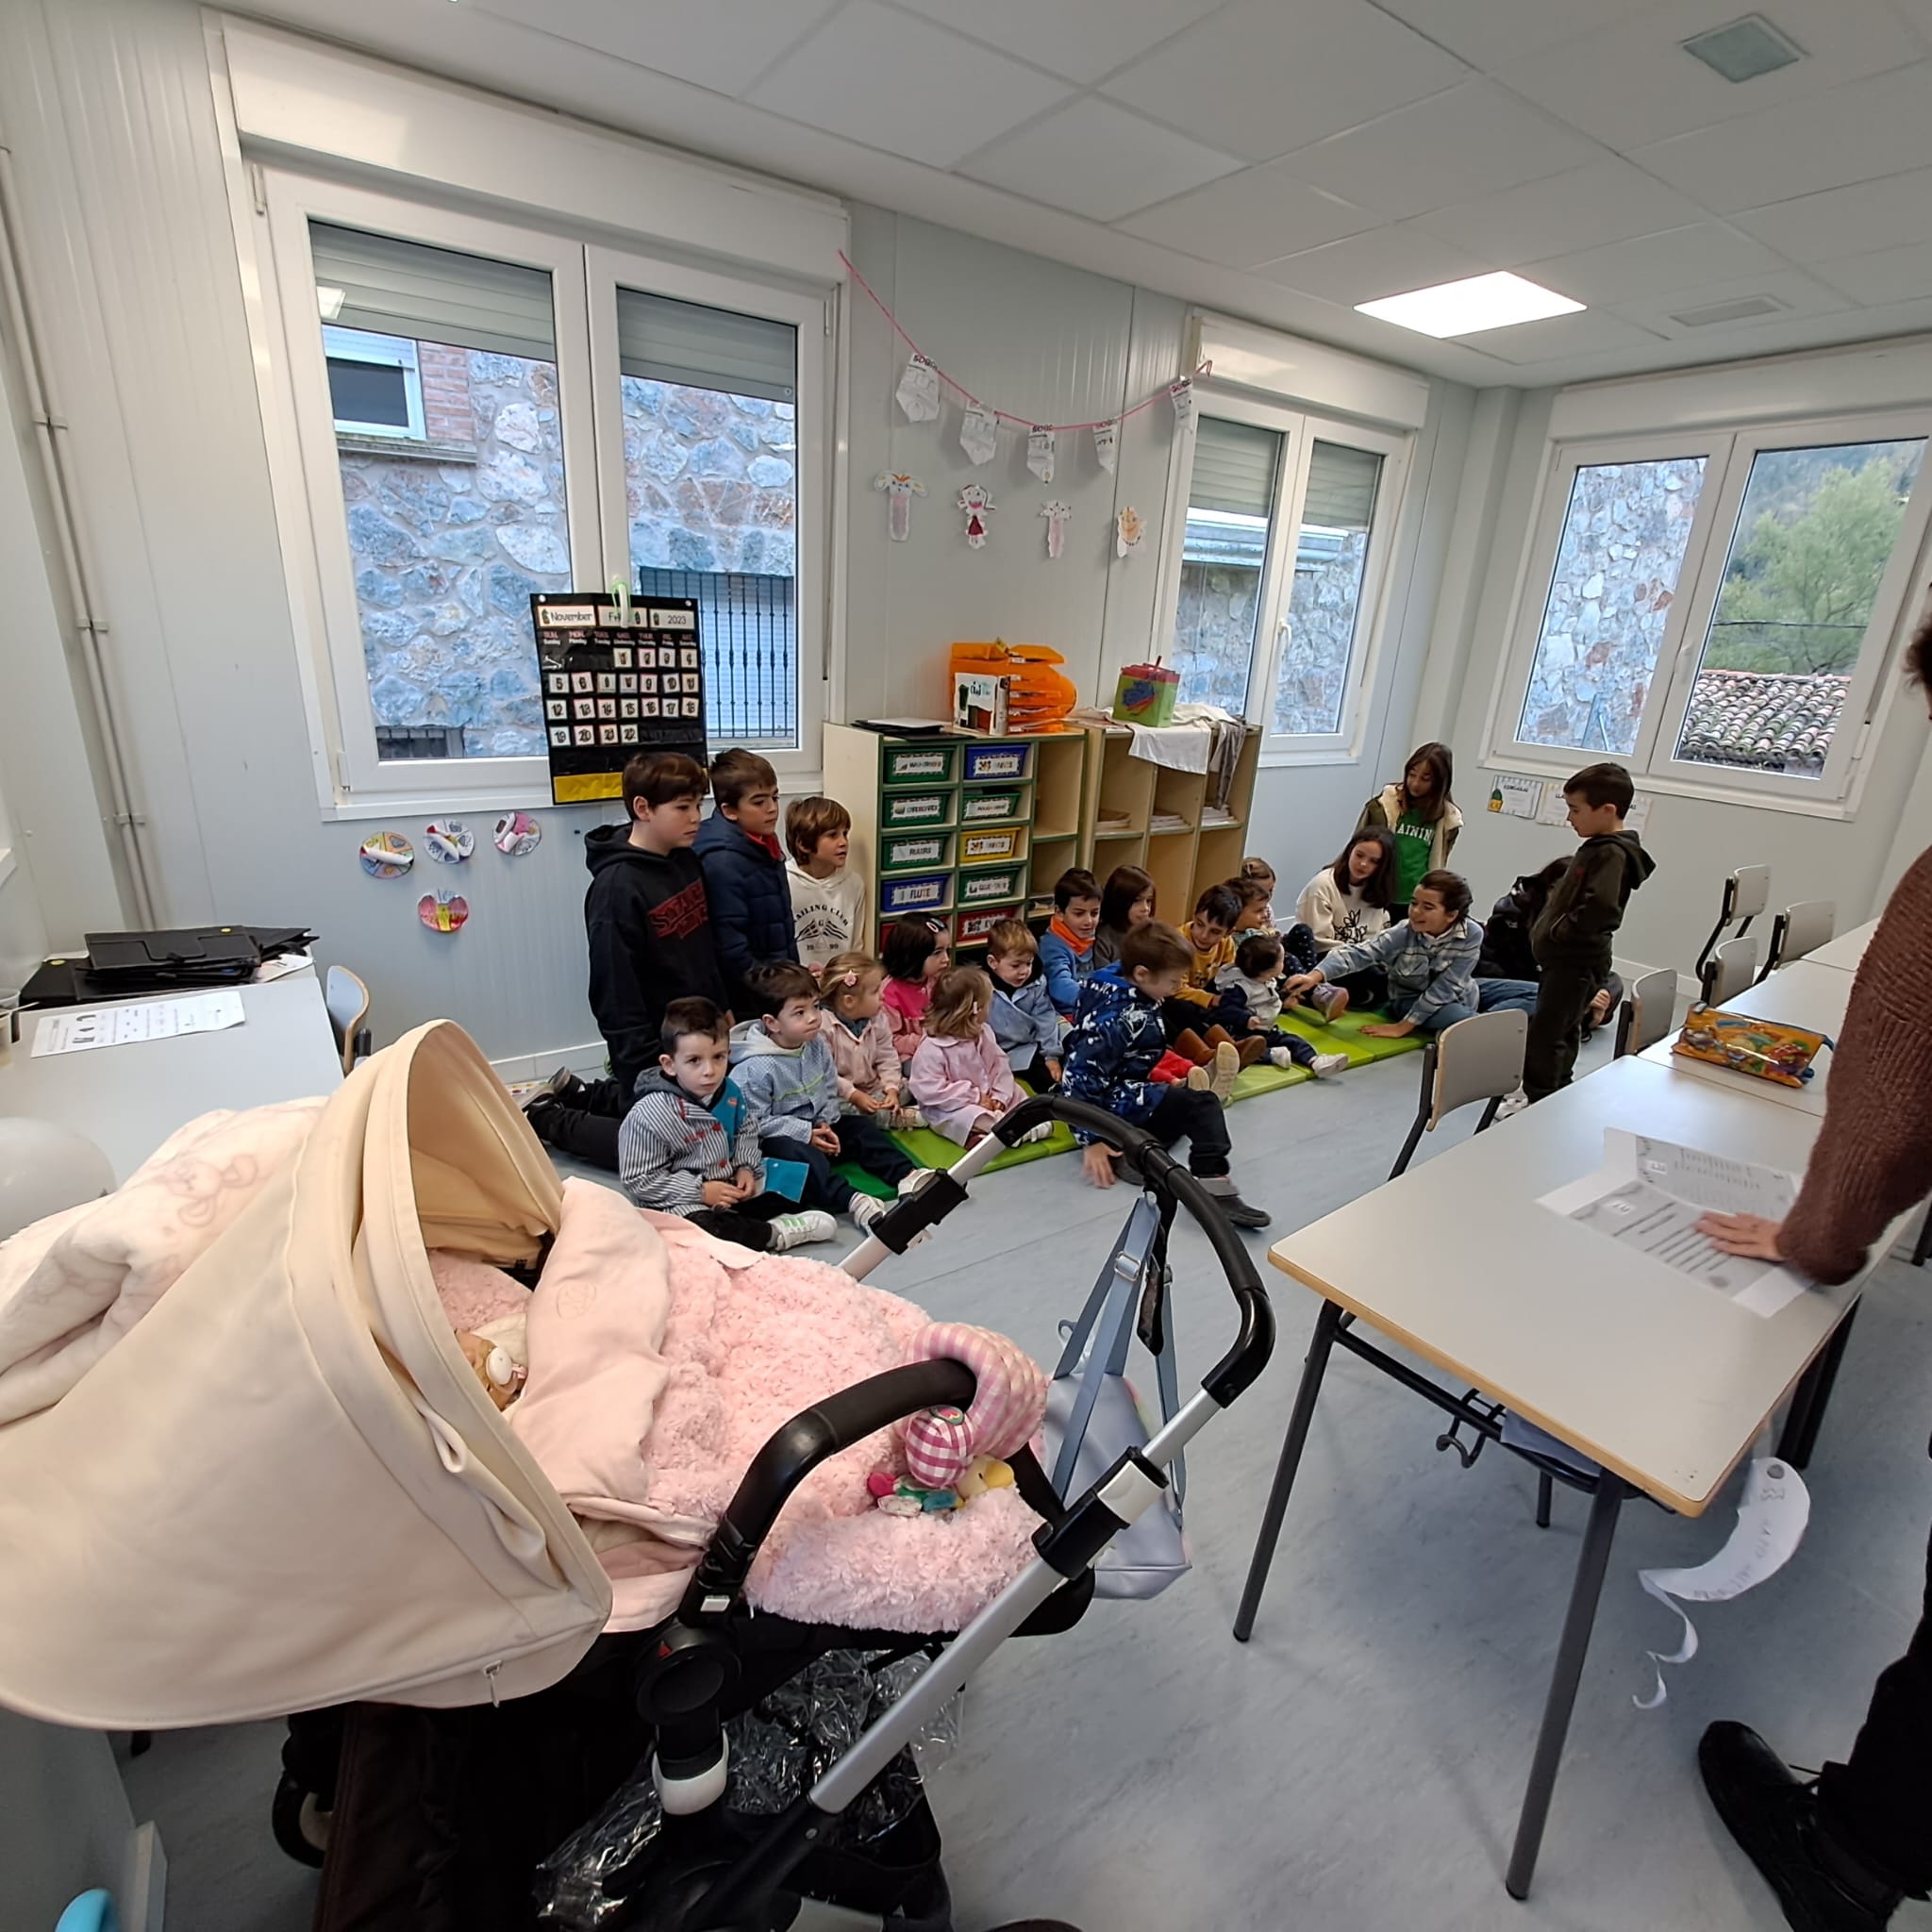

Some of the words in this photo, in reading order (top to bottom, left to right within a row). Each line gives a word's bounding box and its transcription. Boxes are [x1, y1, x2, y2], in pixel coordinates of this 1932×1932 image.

[550, 611, 592, 622] November
[668, 614, 687, 625] 2023
[556, 676, 563, 691] 5
[578, 676, 587, 690] 6
[645, 677, 653, 691] 9
[667, 676, 677, 691] 10
[551, 703, 564, 717] 12
[579, 703, 591, 717] 13
[602, 702, 613, 716] 14
[625, 702, 636, 715] 15
[646, 701, 657, 714] 16
[666, 702, 676, 715] 17
[555, 729, 567, 743] 19
[578, 728, 591, 742] 20
[624, 727, 636, 741] 22
[793, 904, 828, 923] AILING
